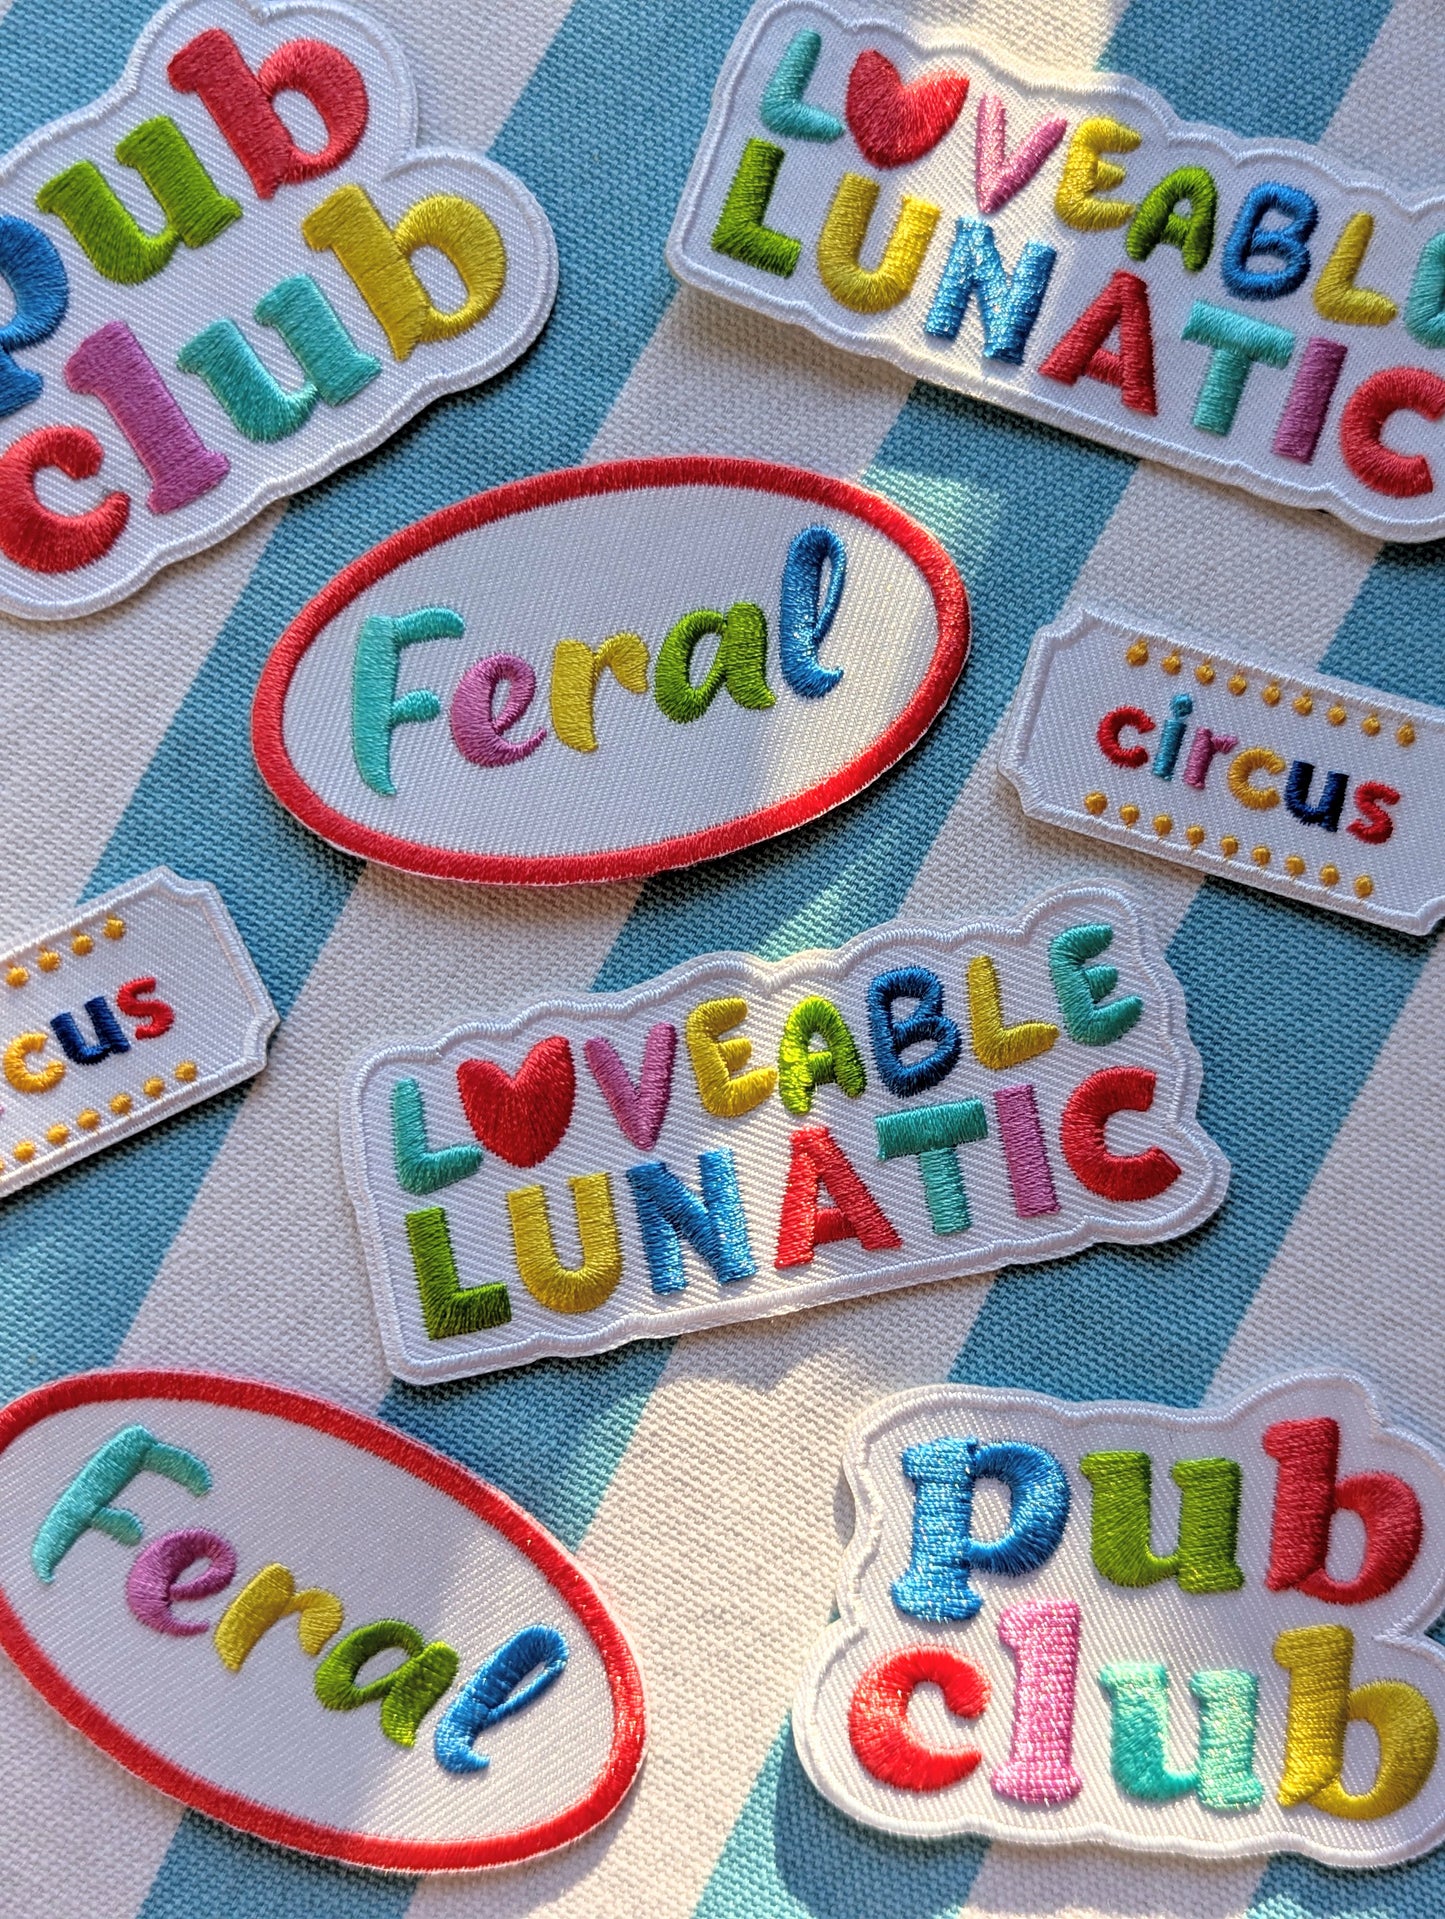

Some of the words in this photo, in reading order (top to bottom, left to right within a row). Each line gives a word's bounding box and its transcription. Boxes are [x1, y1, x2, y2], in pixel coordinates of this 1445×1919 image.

[0, 184, 506, 573] club
[711, 138, 1445, 498] LUNATIC
[351, 525, 846, 796] Feral
[1096, 692, 1400, 844] circus
[0, 976, 174, 1115] cus
[405, 1066, 1181, 1340] LUNATIC
[31, 1424, 568, 1773] Feral
[890, 1417, 1424, 1622] pub
[848, 1600, 1438, 1819] club
